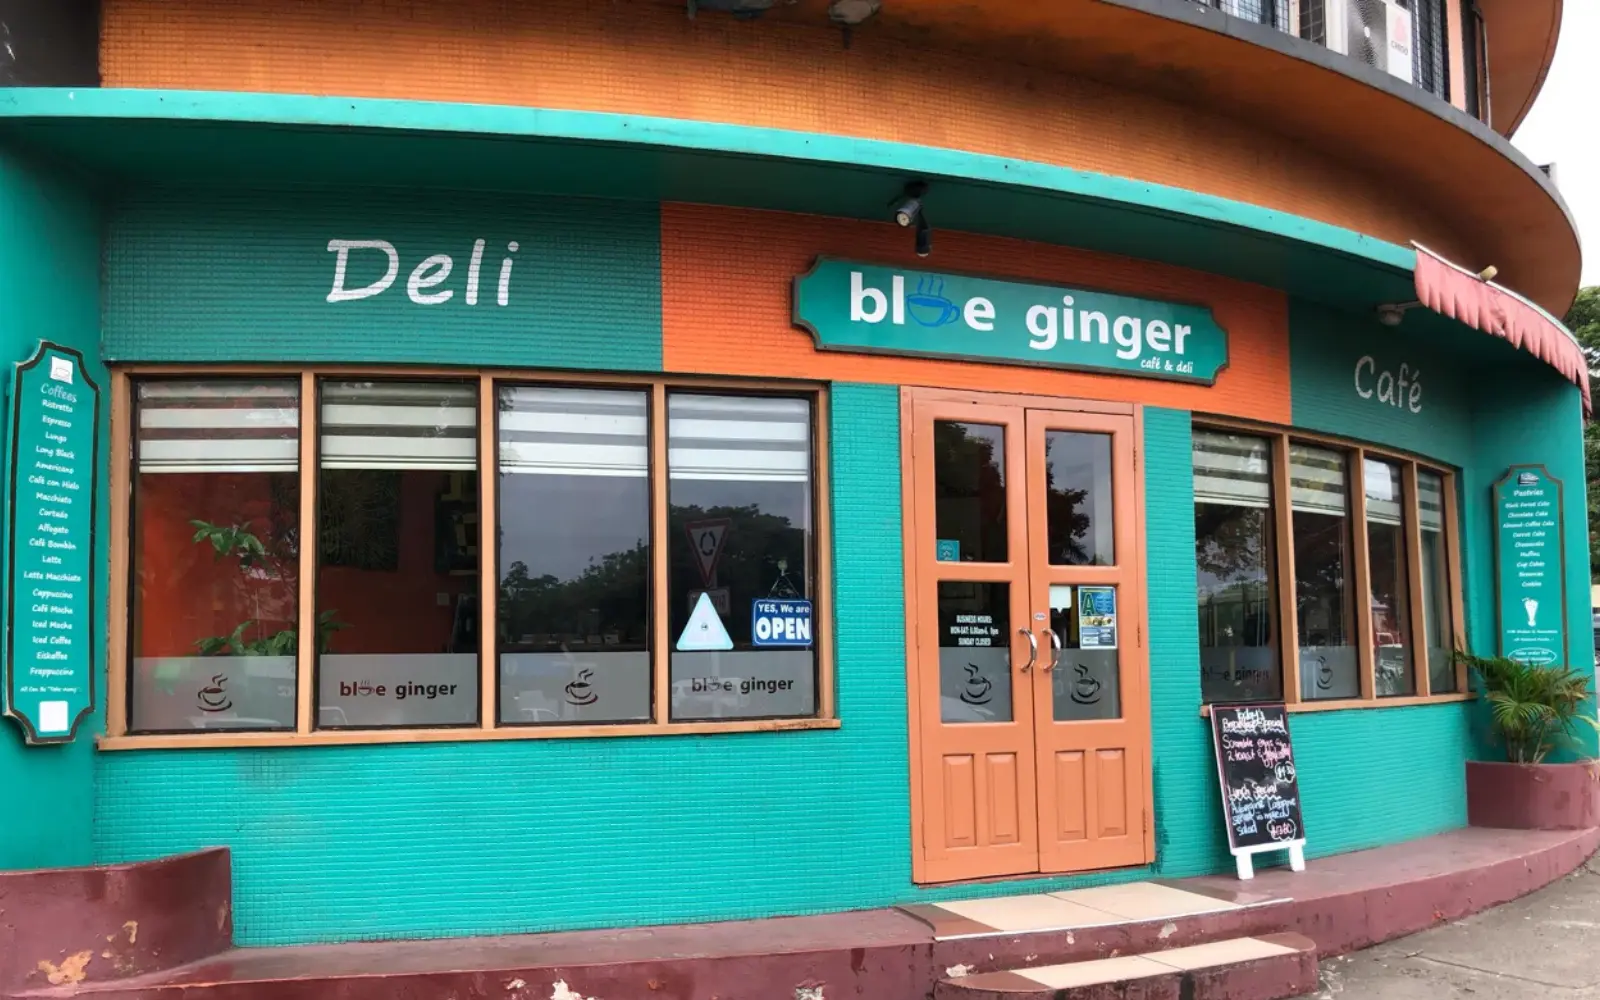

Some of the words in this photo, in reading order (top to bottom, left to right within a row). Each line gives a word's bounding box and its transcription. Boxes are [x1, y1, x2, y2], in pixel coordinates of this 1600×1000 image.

[326, 238, 520, 306] Deli
[1026, 295, 1191, 360] ginger
[1140, 355, 1161, 370] café
[1164, 359, 1174, 371] &
[1176, 360, 1193, 374] deli
[1354, 355, 1422, 414] Café
[41, 383, 77, 403] Coffees
[42, 415, 72, 428] Espresso
[45, 431, 67, 444] Lungo
[35, 445, 54, 458] Long
[55, 447, 75, 460] Black
[35, 461, 74, 474] Americano
[29, 475, 45, 485] Café
[39, 508, 68, 519] Cortado
[29, 538, 45, 547] Café
[42, 555, 62, 564] Latte
[24, 571, 44, 580] Latte
[45, 572, 82, 582] Macchiato
[32, 588, 73, 599] Cappuccino
[32, 604, 48, 613] Café
[50, 605, 73, 614] Mocha
[758, 604, 778, 614] YES,
[780, 604, 793, 613] We
[32, 620, 48, 629] Iced
[49, 620, 73, 630] Mocha
[756, 617, 810, 640] OPEN
[32, 636, 48, 644] Iced
[49, 636, 72, 645] Coffee
[395, 681, 457, 699] ginger
[741, 677, 794, 694] ginger
